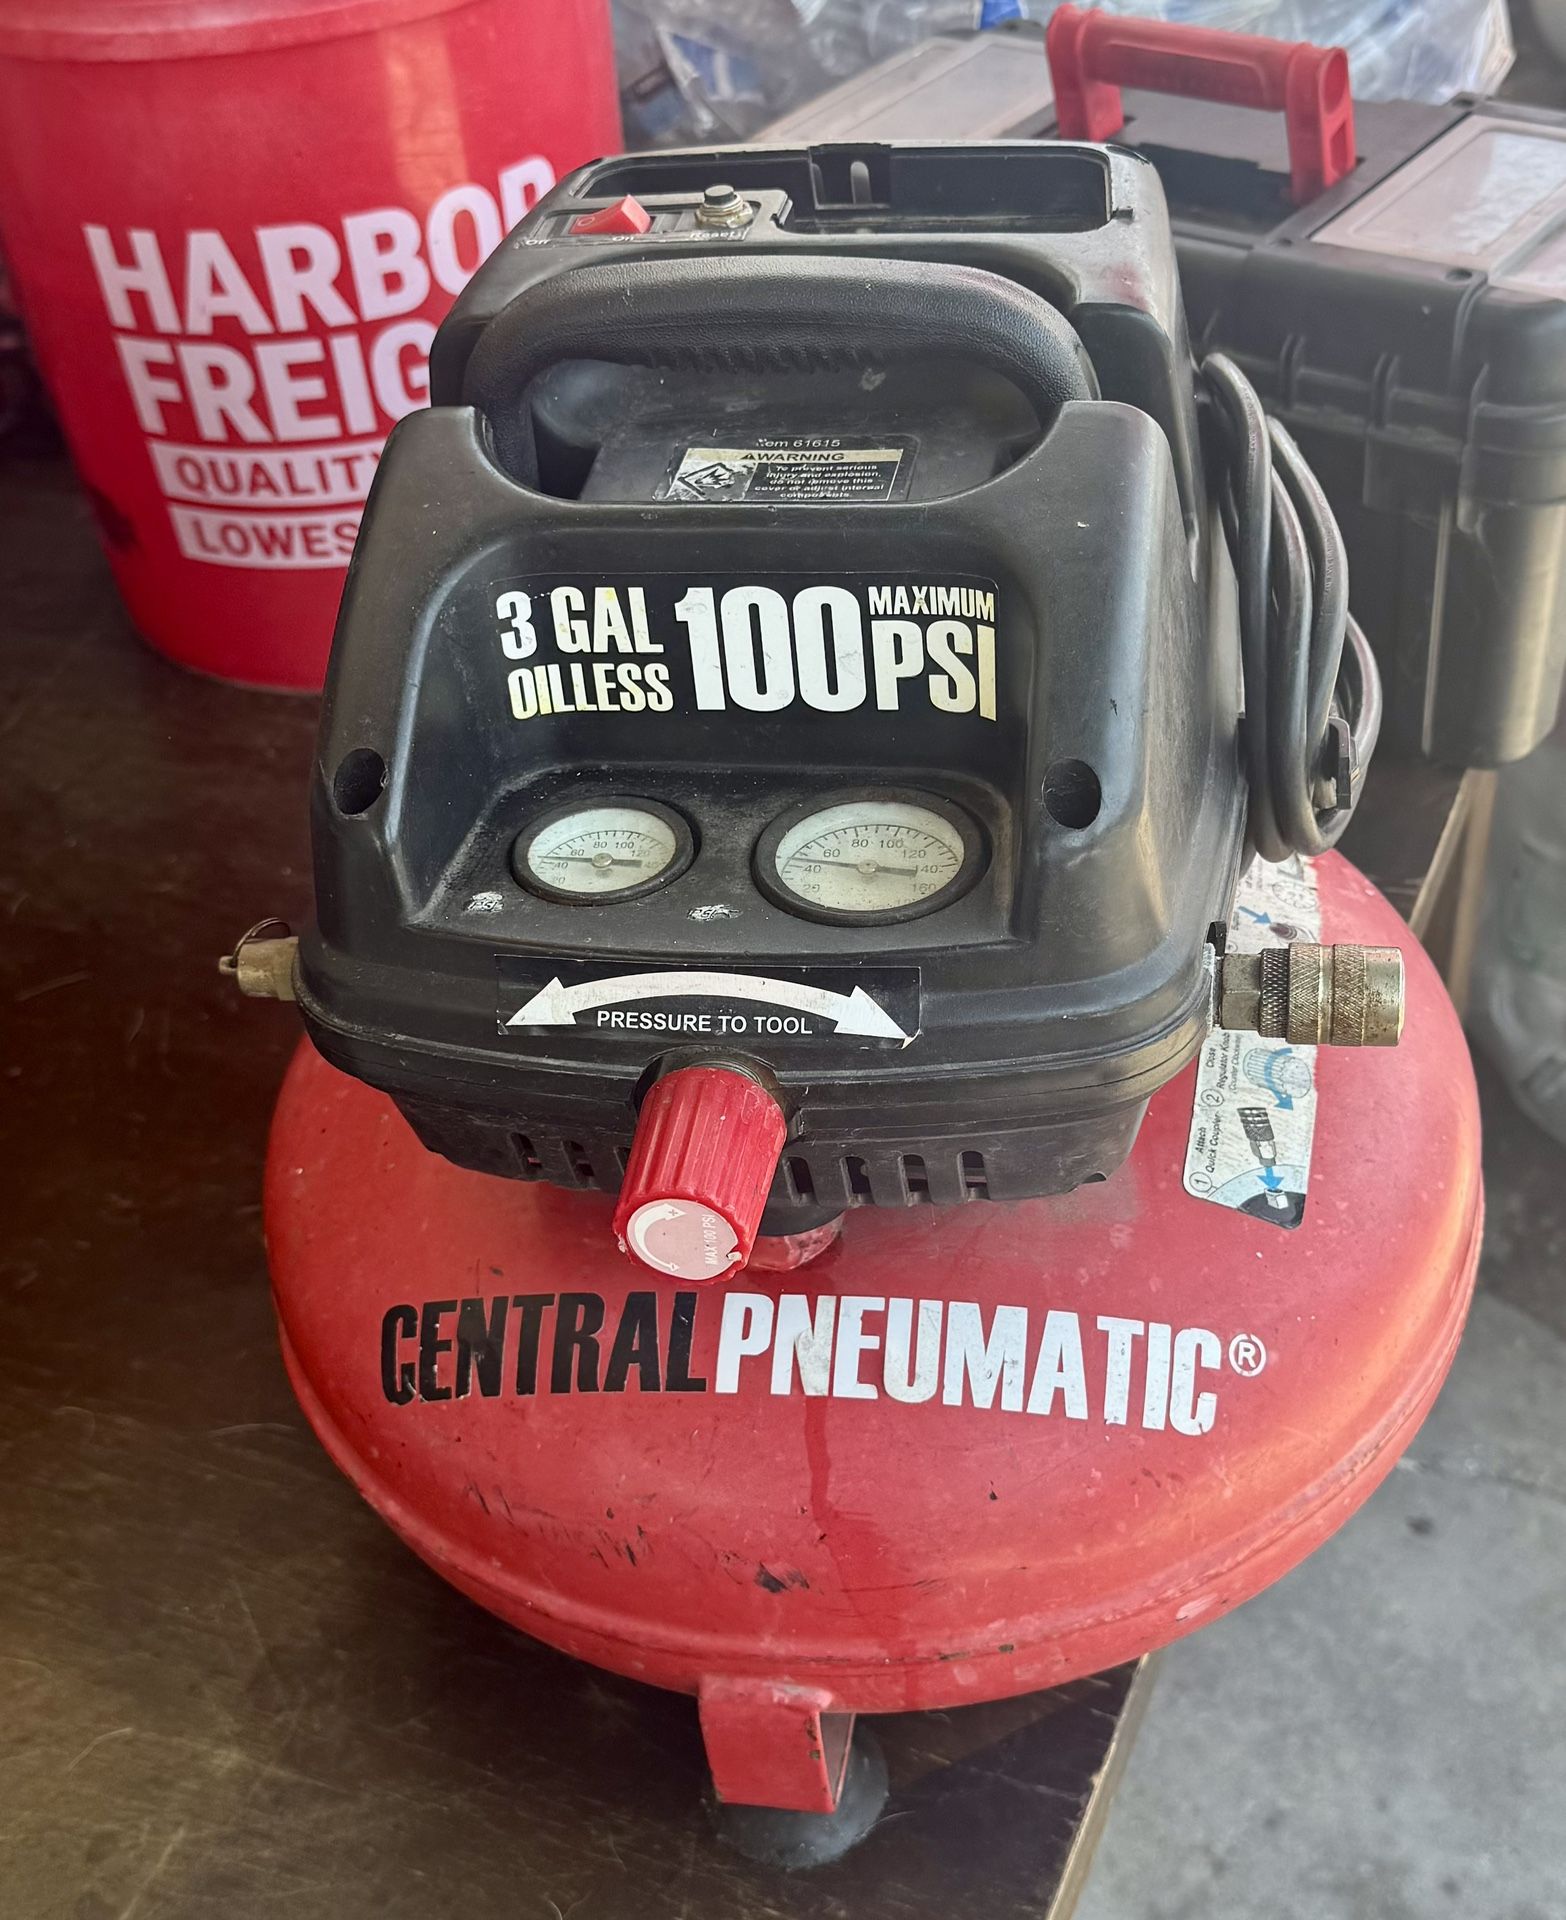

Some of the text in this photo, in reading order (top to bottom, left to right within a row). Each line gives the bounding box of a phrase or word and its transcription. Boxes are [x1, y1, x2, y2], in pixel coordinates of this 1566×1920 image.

[793, 439, 841, 448] 61615
[758, 453, 845, 461] WARNING
[174, 451, 380, 497] QUALIT
[791, 465, 833, 473] prevent
[867, 585, 995, 623] MAXIMUM
[496, 585, 664, 660] 3 GAL
[674, 585, 867, 712] 100
[871, 619, 998, 722] PSI
[507, 662, 674, 720] OILLESS
[593, 841, 608, 849] 80
[615, 841, 635, 849] 100
[851, 839, 869, 848] 80
[879, 839, 904, 849] 100
[570, 849, 585, 857] 60
[823, 849, 841, 858] 60
[903, 849, 927, 859] 120
[803, 865, 822, 874] 40
[912, 882, 937, 893] 160
[597, 1010, 813, 1035] PRESSURE TO TOOL
[1195, 1126, 1206, 1154] Attach
[1205, 1111, 1224, 1174] Quick Coupler
[701, 1214, 718, 1265] MAX 100 PSI
[380, 1291, 708, 1407] CENTRAL
